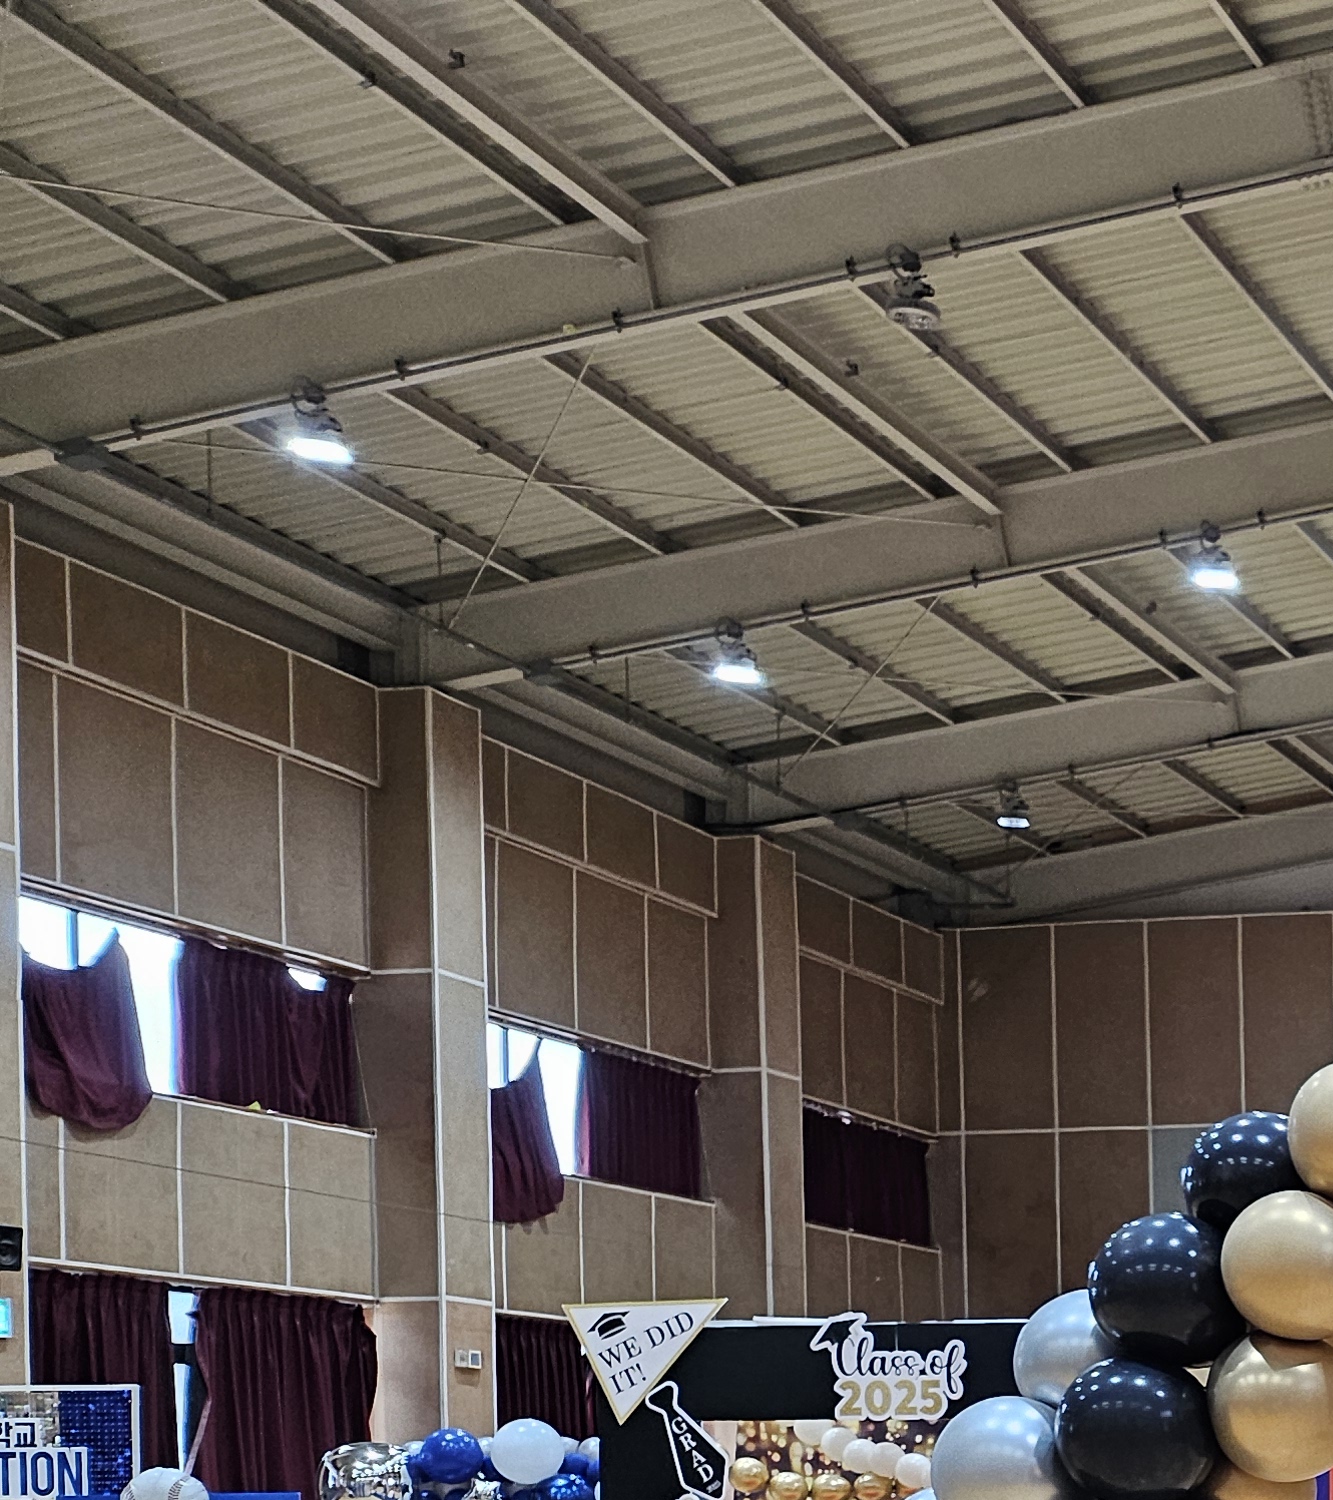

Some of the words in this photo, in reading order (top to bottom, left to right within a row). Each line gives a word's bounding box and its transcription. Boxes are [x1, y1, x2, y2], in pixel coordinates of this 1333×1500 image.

[598, 1336, 642, 1369] WE
[643, 1311, 694, 1350] DID
[836, 1335, 920, 1376] Class
[929, 1344, 962, 1395] of
[609, 1363, 647, 1395] IT!
[839, 1379, 943, 1416] 2025
[671, 1416, 715, 1484] GRAD
